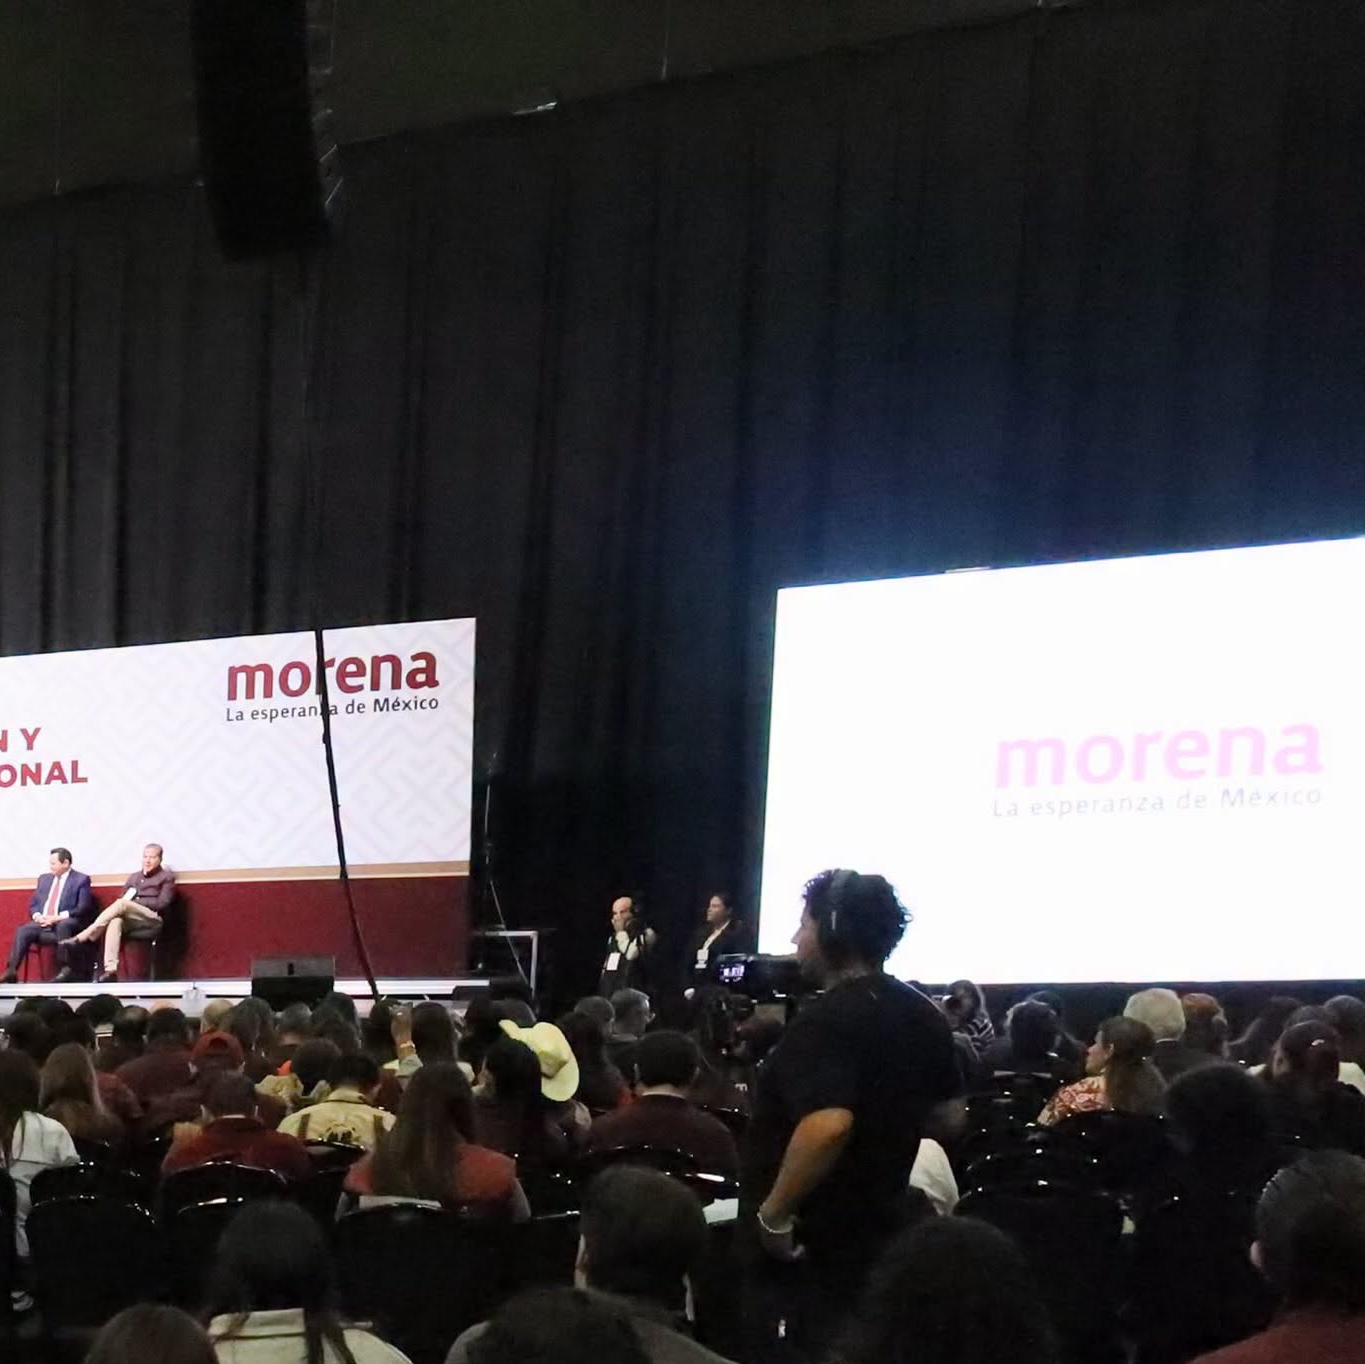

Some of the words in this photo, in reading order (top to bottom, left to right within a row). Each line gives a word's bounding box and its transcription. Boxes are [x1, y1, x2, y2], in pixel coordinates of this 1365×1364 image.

[227, 651, 440, 701] morena
[226, 707, 244, 722] La
[345, 698, 366, 715] de
[372, 696, 439, 713] México
[19, 727, 42, 751] Y
[995, 722, 1325, 789] morena
[993, 799, 1019, 819] La
[1031, 794, 1165, 821] esperanza
[1175, 788, 1207, 809] de
[1220, 785, 1322, 808] México
